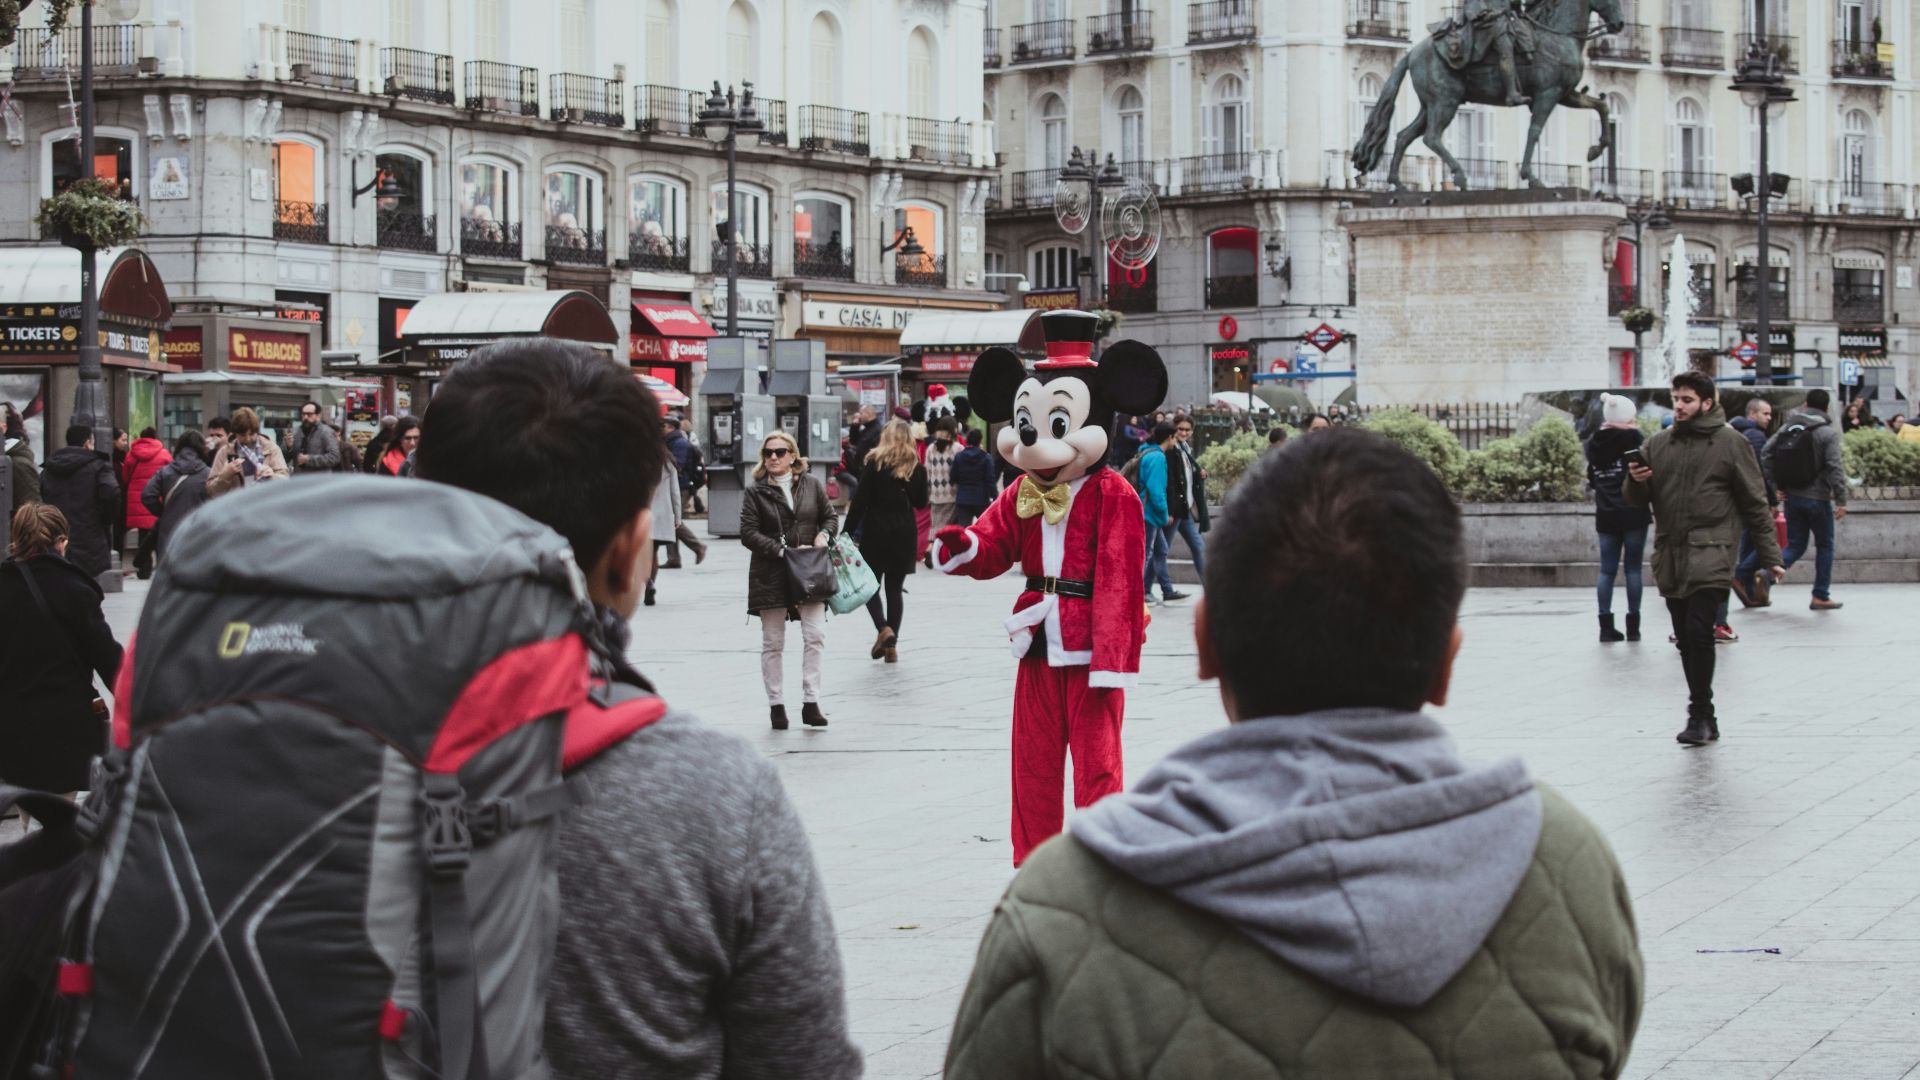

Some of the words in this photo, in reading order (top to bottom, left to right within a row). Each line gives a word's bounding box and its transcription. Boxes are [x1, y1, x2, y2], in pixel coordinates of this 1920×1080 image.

[1839, 258, 1880, 267] RODILLA
[1025, 294, 1077, 308] SOUVENIRS
[839, 307, 883, 327] CASA
[8, 327, 61, 340] TICKETS
[107, 331, 125, 350] TOURS
[1840, 335, 1881, 346] RODILLA
[160, 342, 201, 353] BACOS
[251, 340, 302, 361] TABACOS
[439, 348, 469, 359] TOURS
[679, 343, 708, 356] CHANG
[1212, 348, 1249, 360] vodafon
